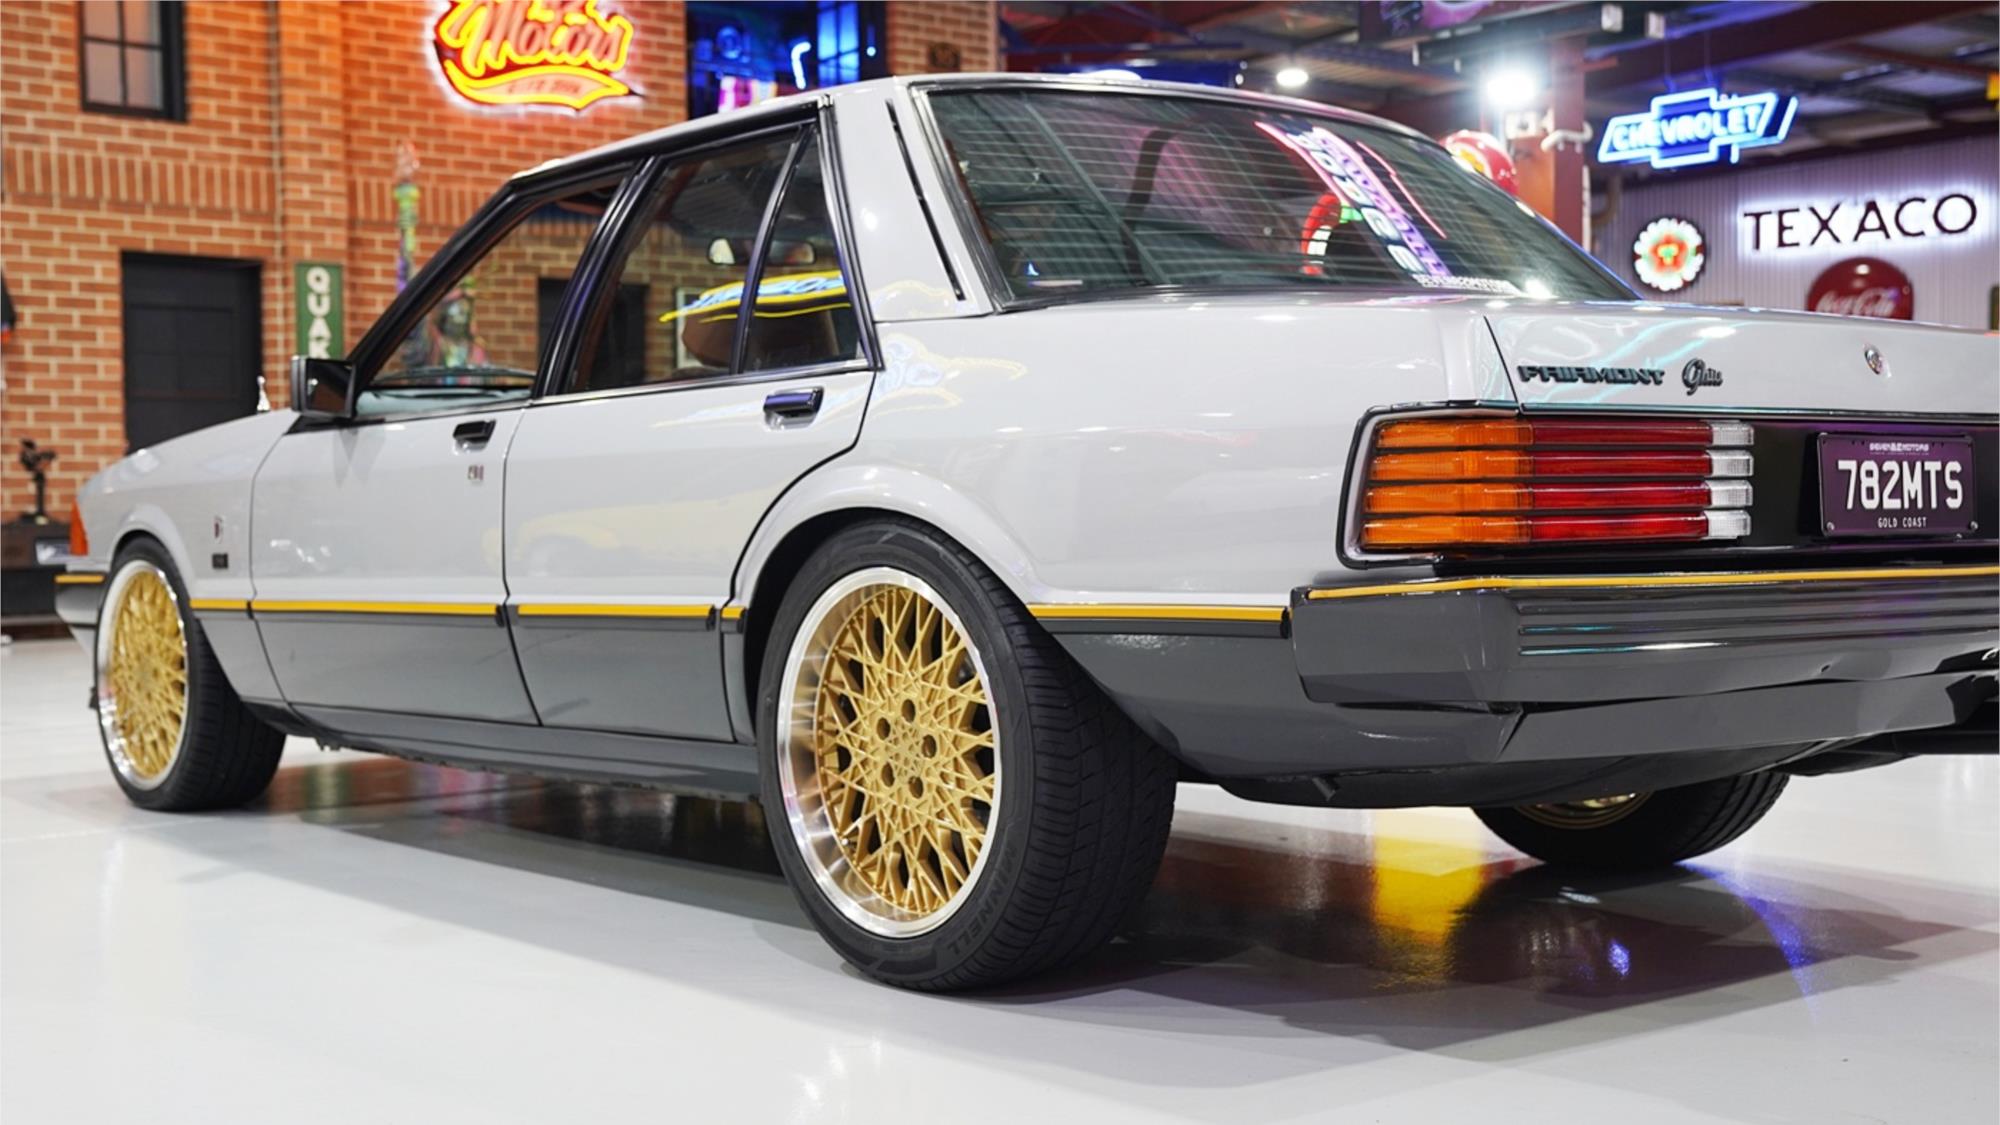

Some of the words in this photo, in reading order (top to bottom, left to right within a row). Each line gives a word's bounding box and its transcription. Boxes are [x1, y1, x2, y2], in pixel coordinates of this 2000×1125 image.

[440, 1, 634, 77] Motors
[1612, 104, 1763, 151] CHEVROLET
[1743, 193, 1978, 251] TEXACO
[1517, 365, 1664, 385] FAIRMONT
[1682, 358, 1724, 396] Ghia
[1837, 460, 1963, 510] 782MTS
[1877, 516, 1898, 528] GOLD
[1902, 516, 1927, 528] COAST
